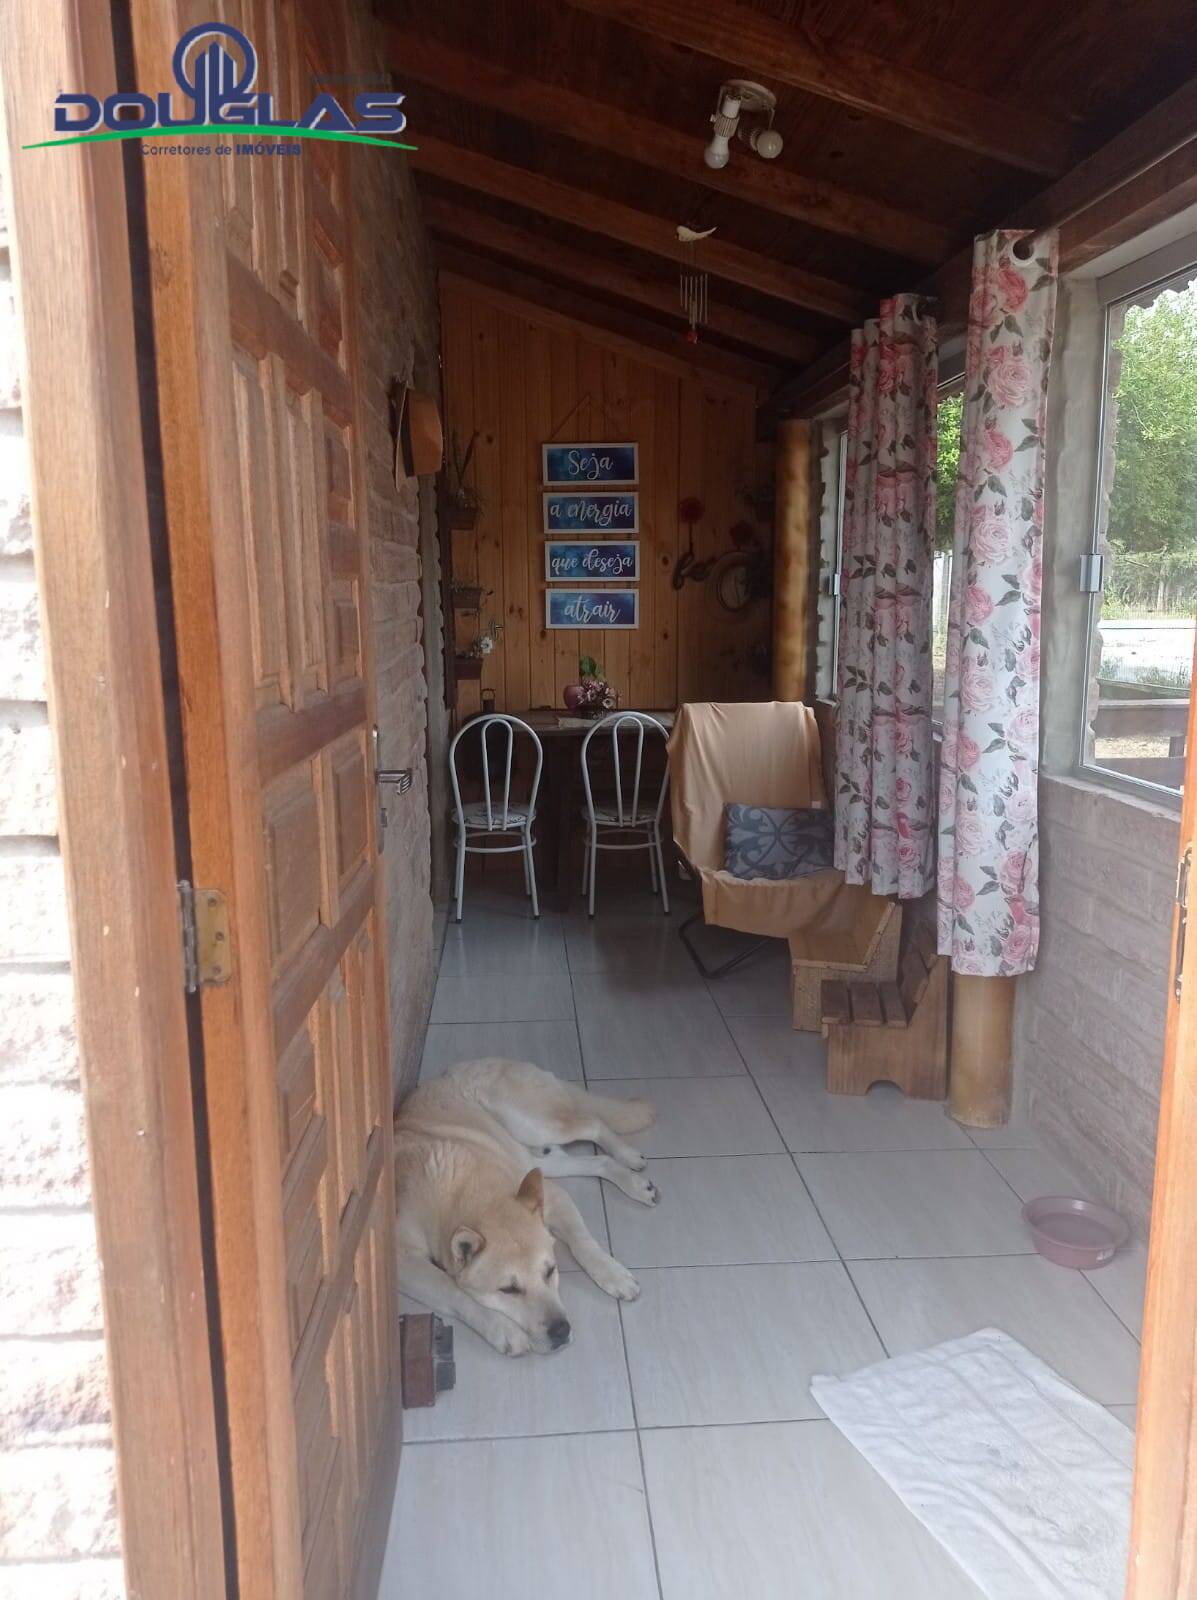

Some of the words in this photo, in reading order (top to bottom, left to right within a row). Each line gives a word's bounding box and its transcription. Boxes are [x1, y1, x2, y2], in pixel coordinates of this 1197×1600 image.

[568, 450, 613, 480] Seja
[550, 504, 562, 518] a
[567, 500, 633, 527] energia
[551, 557, 579, 576] que
[582, 548, 633, 575] deseja
[564, 595, 620, 623] atrair
